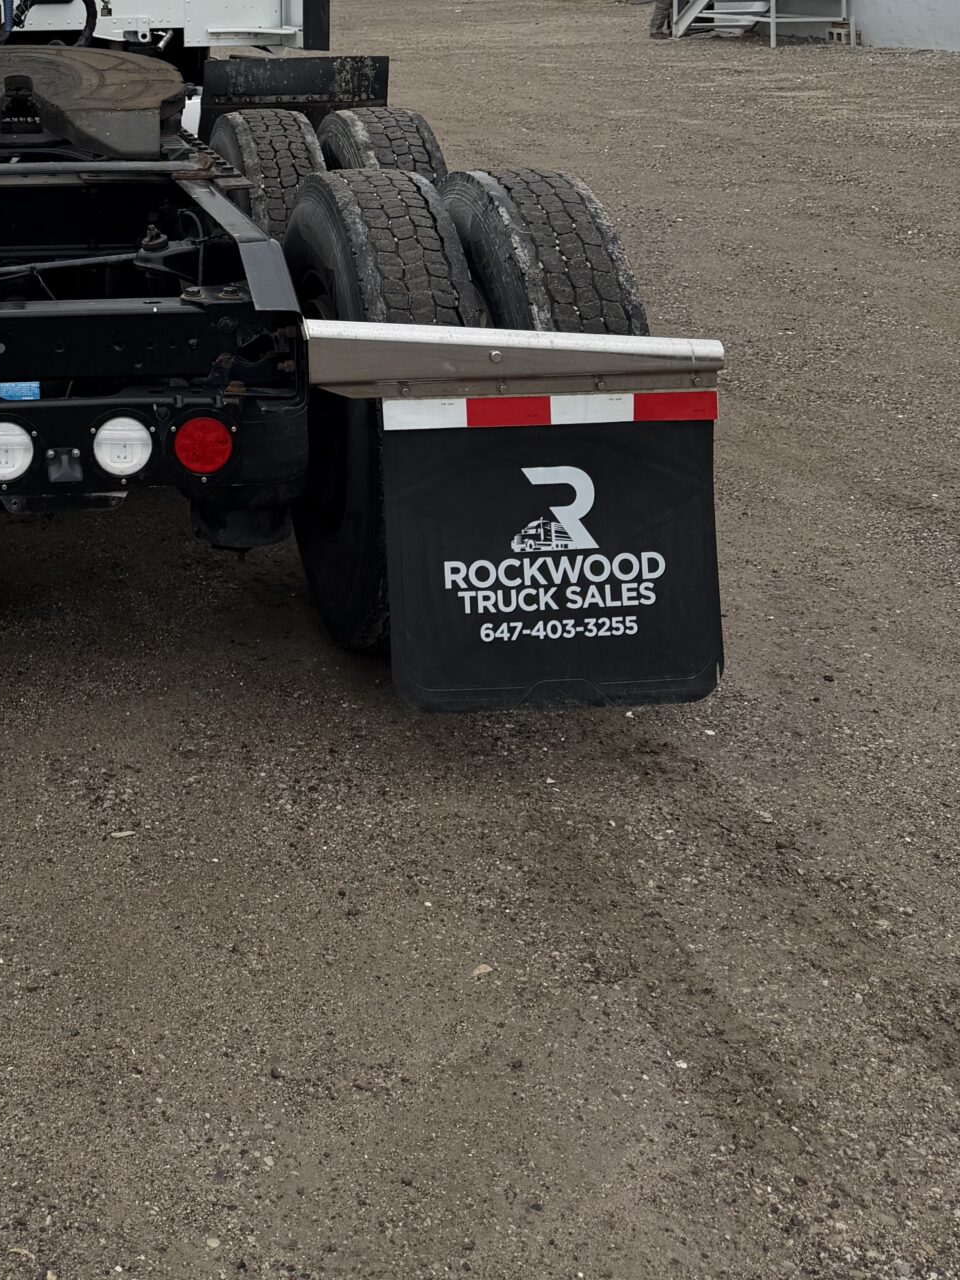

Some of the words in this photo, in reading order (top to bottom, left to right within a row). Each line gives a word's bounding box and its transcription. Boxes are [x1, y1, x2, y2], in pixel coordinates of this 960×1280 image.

[443, 551, 666, 589] ROCKWOOD
[457, 586, 560, 614] TRUCK
[565, 581, 657, 609] SALES
[479, 615, 639, 643] 647-403-3255
